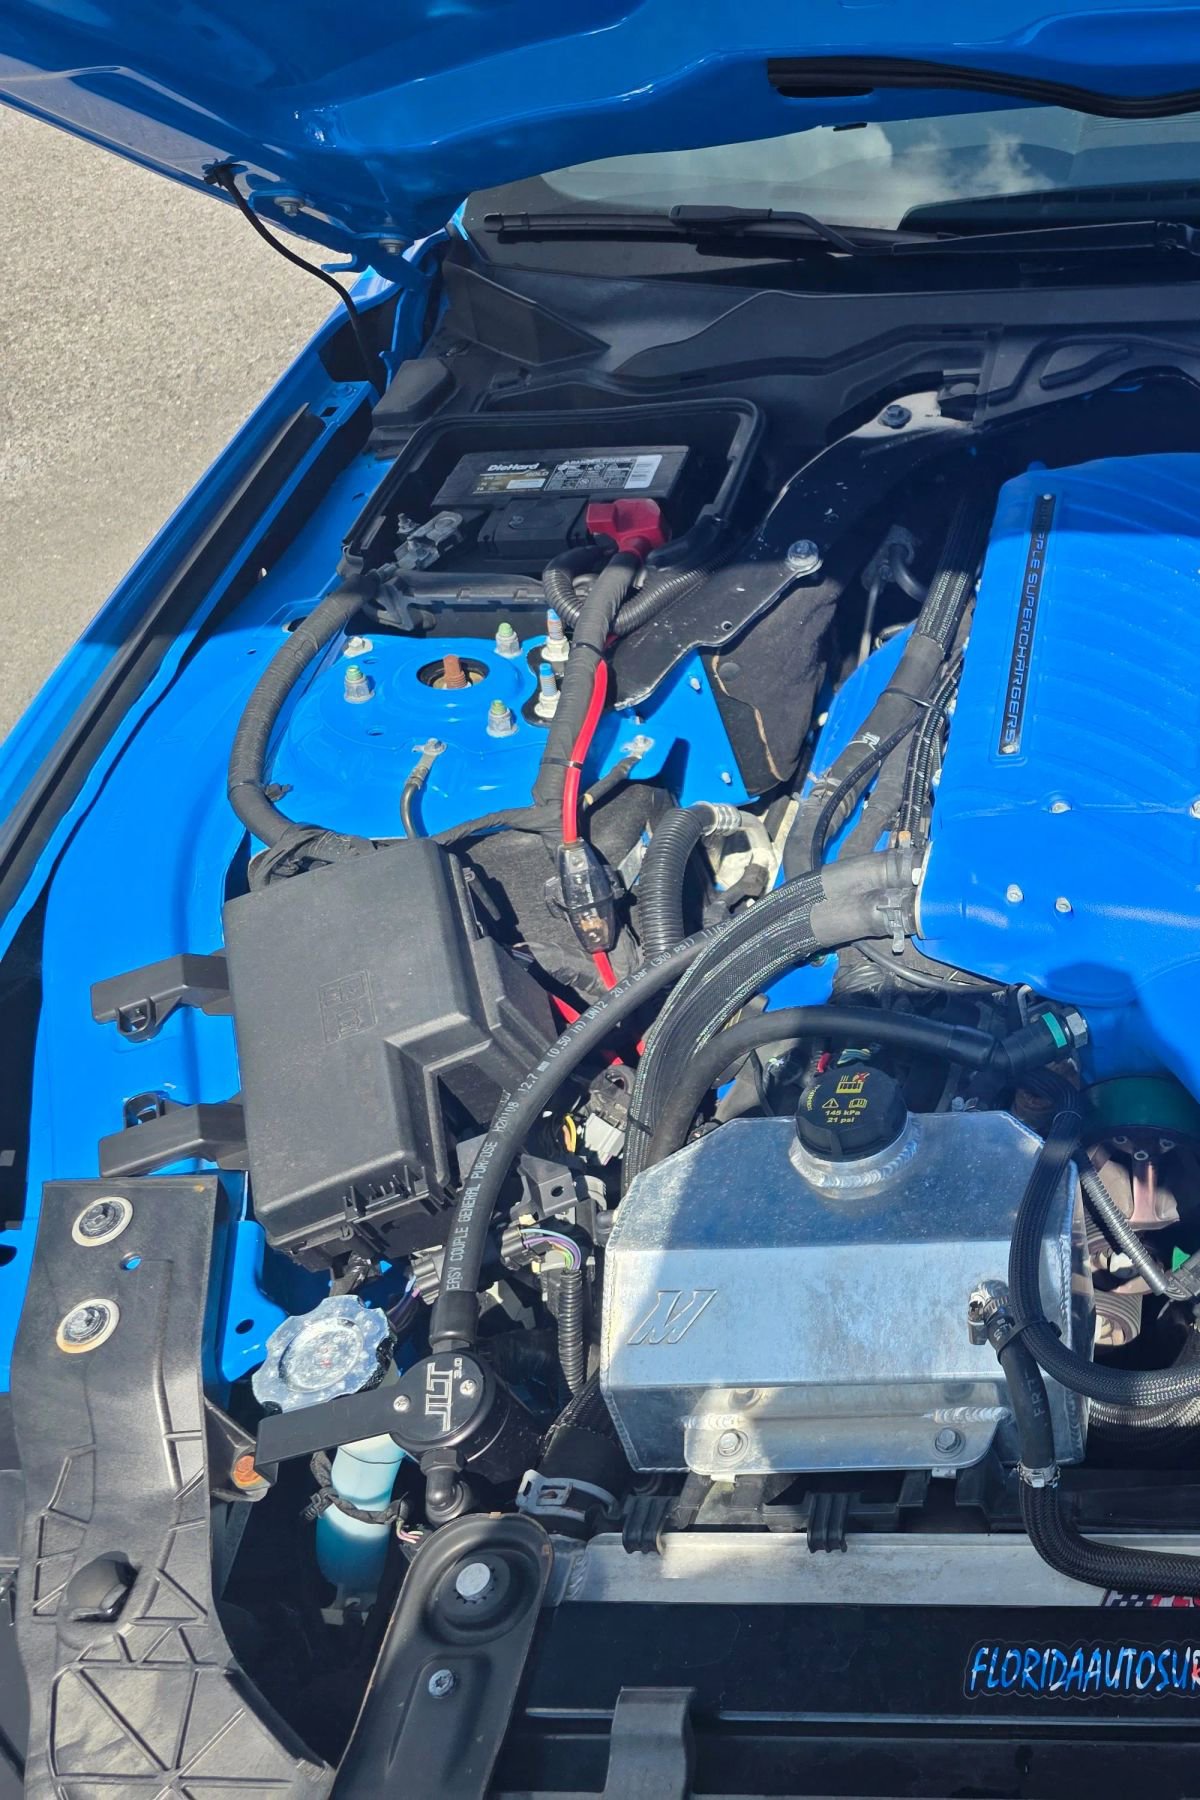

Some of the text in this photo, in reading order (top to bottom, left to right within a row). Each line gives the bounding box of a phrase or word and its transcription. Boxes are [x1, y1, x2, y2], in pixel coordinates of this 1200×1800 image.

[487, 462, 540, 472] DieHard
[1005, 572, 1038, 742] SUPERCHARGERS
[631, 967, 649, 981] bar
[470, 1141, 498, 1179] PURPOSE
[458, 1183, 481, 1223] GENERAL
[450, 1227, 469, 1261] COUPLE
[446, 1266, 464, 1291] EASY
[425, 1362, 453, 1432] JLT
